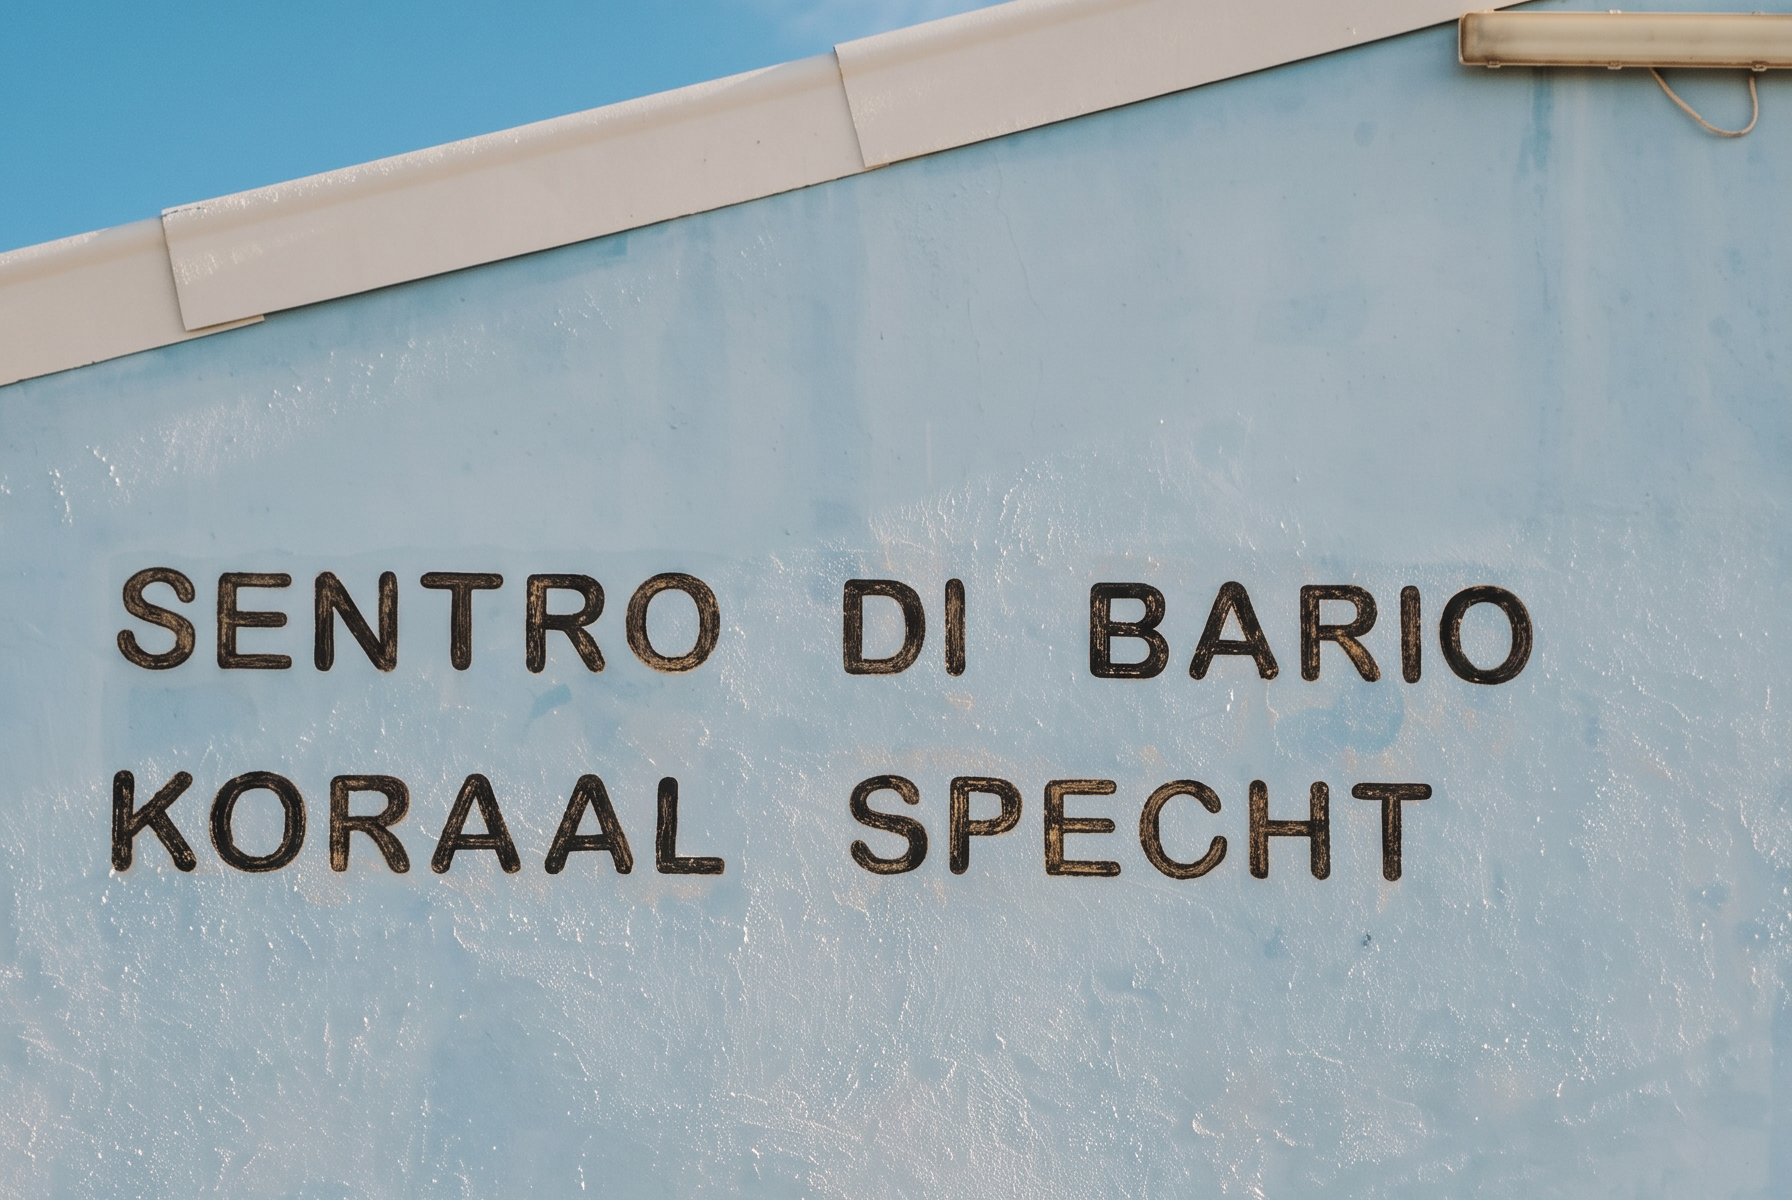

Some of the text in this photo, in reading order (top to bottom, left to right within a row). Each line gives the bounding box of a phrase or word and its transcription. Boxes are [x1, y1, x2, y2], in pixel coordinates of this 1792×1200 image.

[115, 565, 1534, 686] SENTRO DI BARIO
[111, 768, 1434, 883] KORAAL SPECHT
